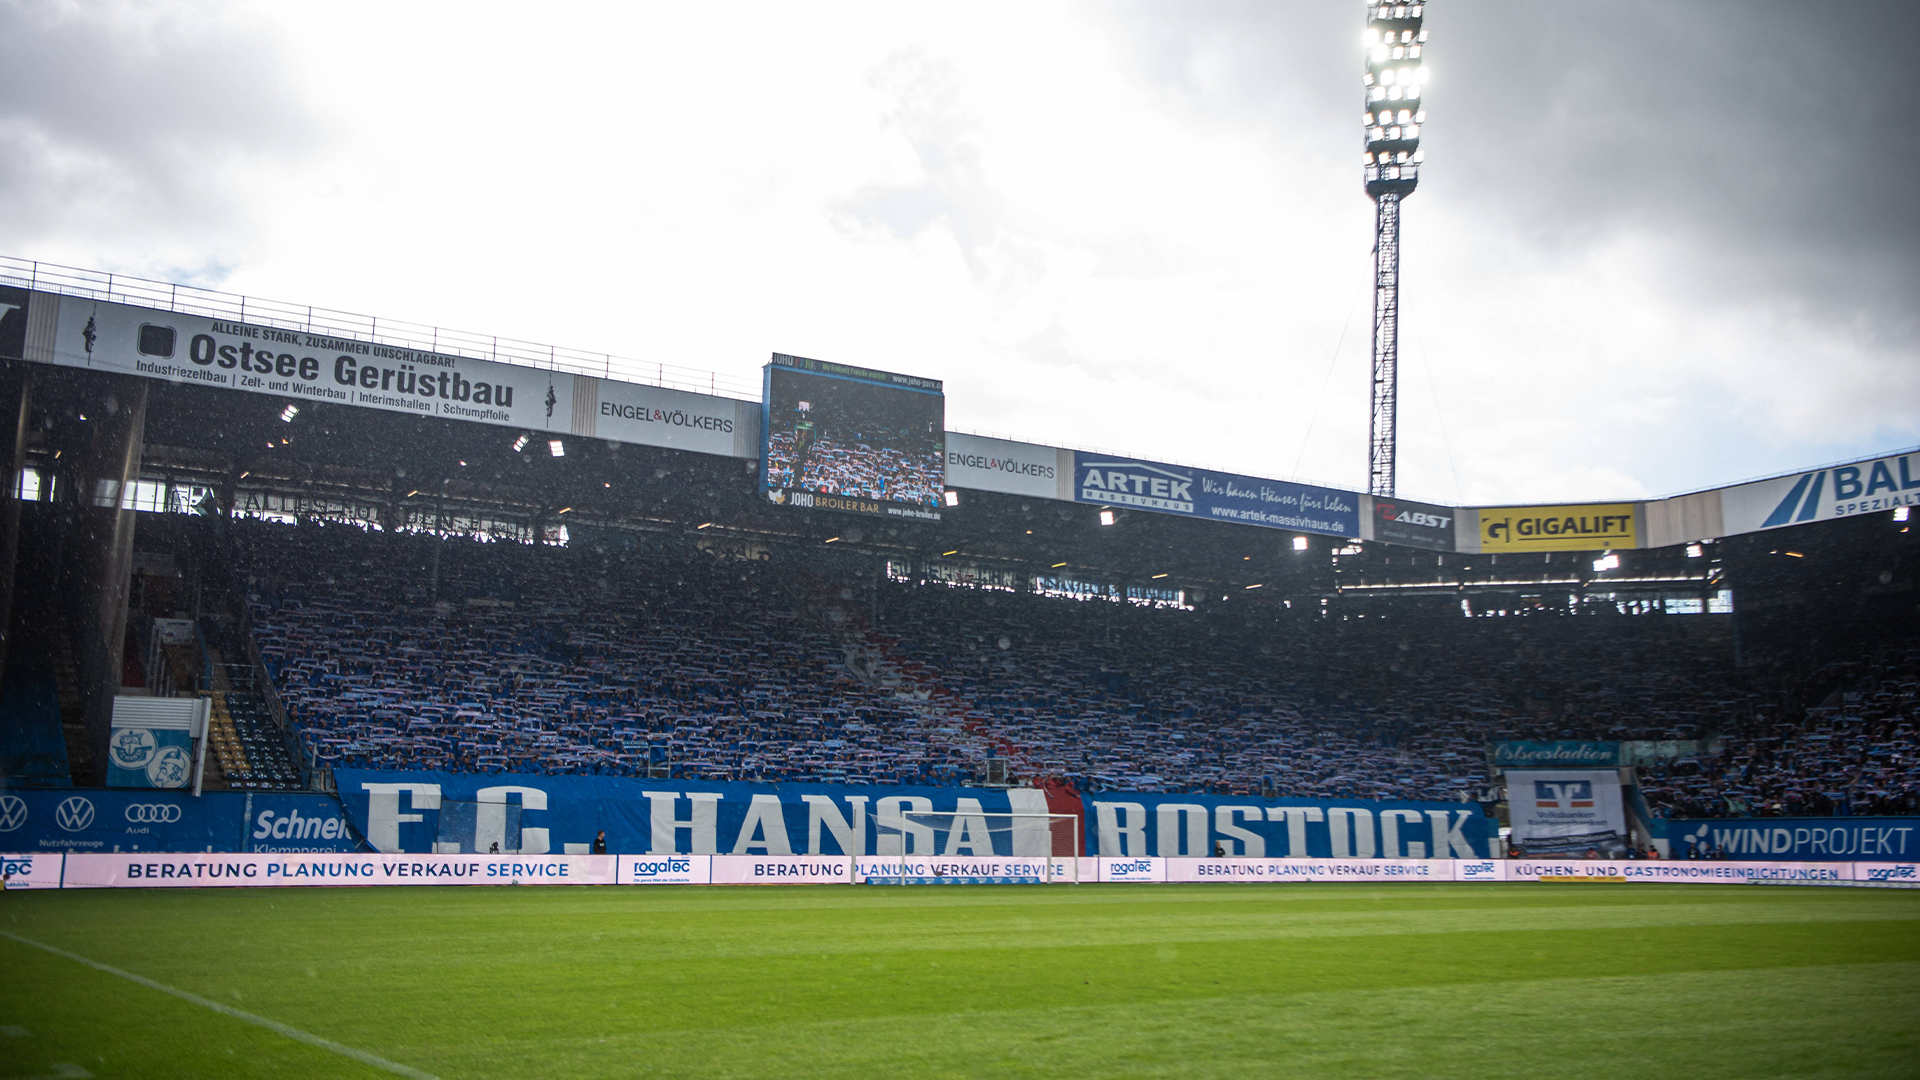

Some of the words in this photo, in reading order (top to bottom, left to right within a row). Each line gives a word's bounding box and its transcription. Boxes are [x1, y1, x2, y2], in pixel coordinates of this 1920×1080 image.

[211, 322, 259, 339] ALLEINE
[262, 329, 302, 346] STARK,
[305, 336, 370, 355] ZUSAMMEN
[373, 346, 455, 369] UNSCHLAGBAR!
[189, 333, 320, 381] Ostsee
[334, 355, 513, 408] Gerüstbau
[136, 360, 227, 383] Industriezeltbau
[240, 375, 265, 388] Zelt-
[268, 380, 288, 392] und
[292, 382, 346, 400] Winterbau
[359, 391, 431, 412] Interimshallen
[443, 403, 510, 422] Schrumpffolie
[601, 401, 733, 433] ENGEL&VÖLKERS
[948, 452, 1054, 479] ENGEL&VÖLKERS
[1082, 469, 1193, 501] ARTEK
[1202, 476, 1224, 495] Wir
[1226, 482, 1258, 500] bauen
[1260, 486, 1298, 506] Häuser
[1300, 493, 1322, 513] fürs
[1324, 495, 1352, 513] Leben
[789, 492, 814, 508] JOHO
[815, 496, 858, 512] BROILER
[860, 502, 880, 514] BAR
[1086, 490, 1190, 510] MASSIVHAUS
[1211, 505, 1345, 533] www.artek-massivhaus.de
[1394, 510, 1452, 529] ABST
[1516, 515, 1631, 536] GIGALIFT
[1495, 742, 1612, 761] Ostseestadion
[126, 826, 150, 834] Audi
[642, 790, 996, 857] HANSA
[1092, 801, 1479, 858] ROSTOCK
[39, 839, 104, 848] Nutzfahrzeuge
[1712, 826, 1914, 856] WINDPROJEKT
[127, 863, 257, 879] BERATUNG
[267, 862, 374, 878] PLANUNG
[382, 863, 480, 878] VERKAUF
[486, 863, 569, 877] SERVICE
[634, 856, 691, 876] rogatec
[754, 863, 844, 876] BERATUNG
[930, 863, 1000, 876] VERKAUF
[1004, 863, 1064, 876] SERVICE
[1110, 858, 1152, 875] rogatec
[1198, 864, 1264, 876] BERATUNG
[1268, 864, 1325, 876] PLANUNG
[1328, 864, 1381, 876] VERKAUF
[1384, 864, 1429, 876] SERVICE
[1515, 864, 1580, 876] KÜCHEN-
[1586, 866, 1618, 877] UND
[1623, 866, 1839, 880] GASTRONOMIEEINRICHTUNGEN
